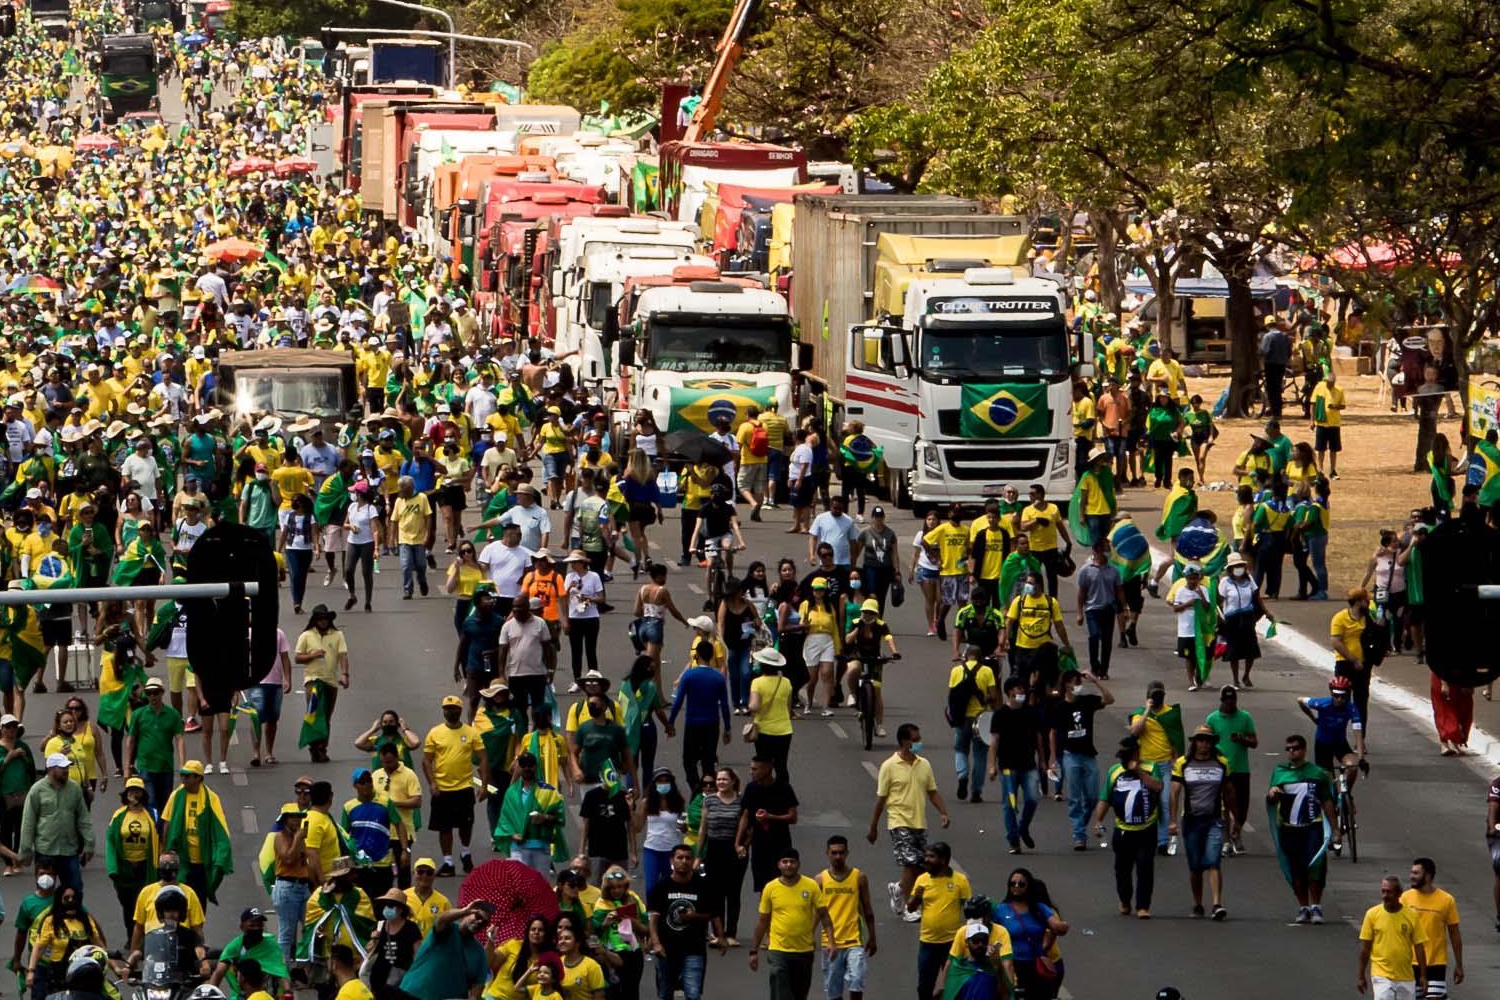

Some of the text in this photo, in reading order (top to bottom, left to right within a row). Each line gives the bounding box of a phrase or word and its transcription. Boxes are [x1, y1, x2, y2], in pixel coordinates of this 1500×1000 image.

[768, 151, 794, 160] SENHOR
[659, 361, 686, 371] NAS
[1114, 778, 1142, 823] 7
[1282, 782, 1310, 825] 7
